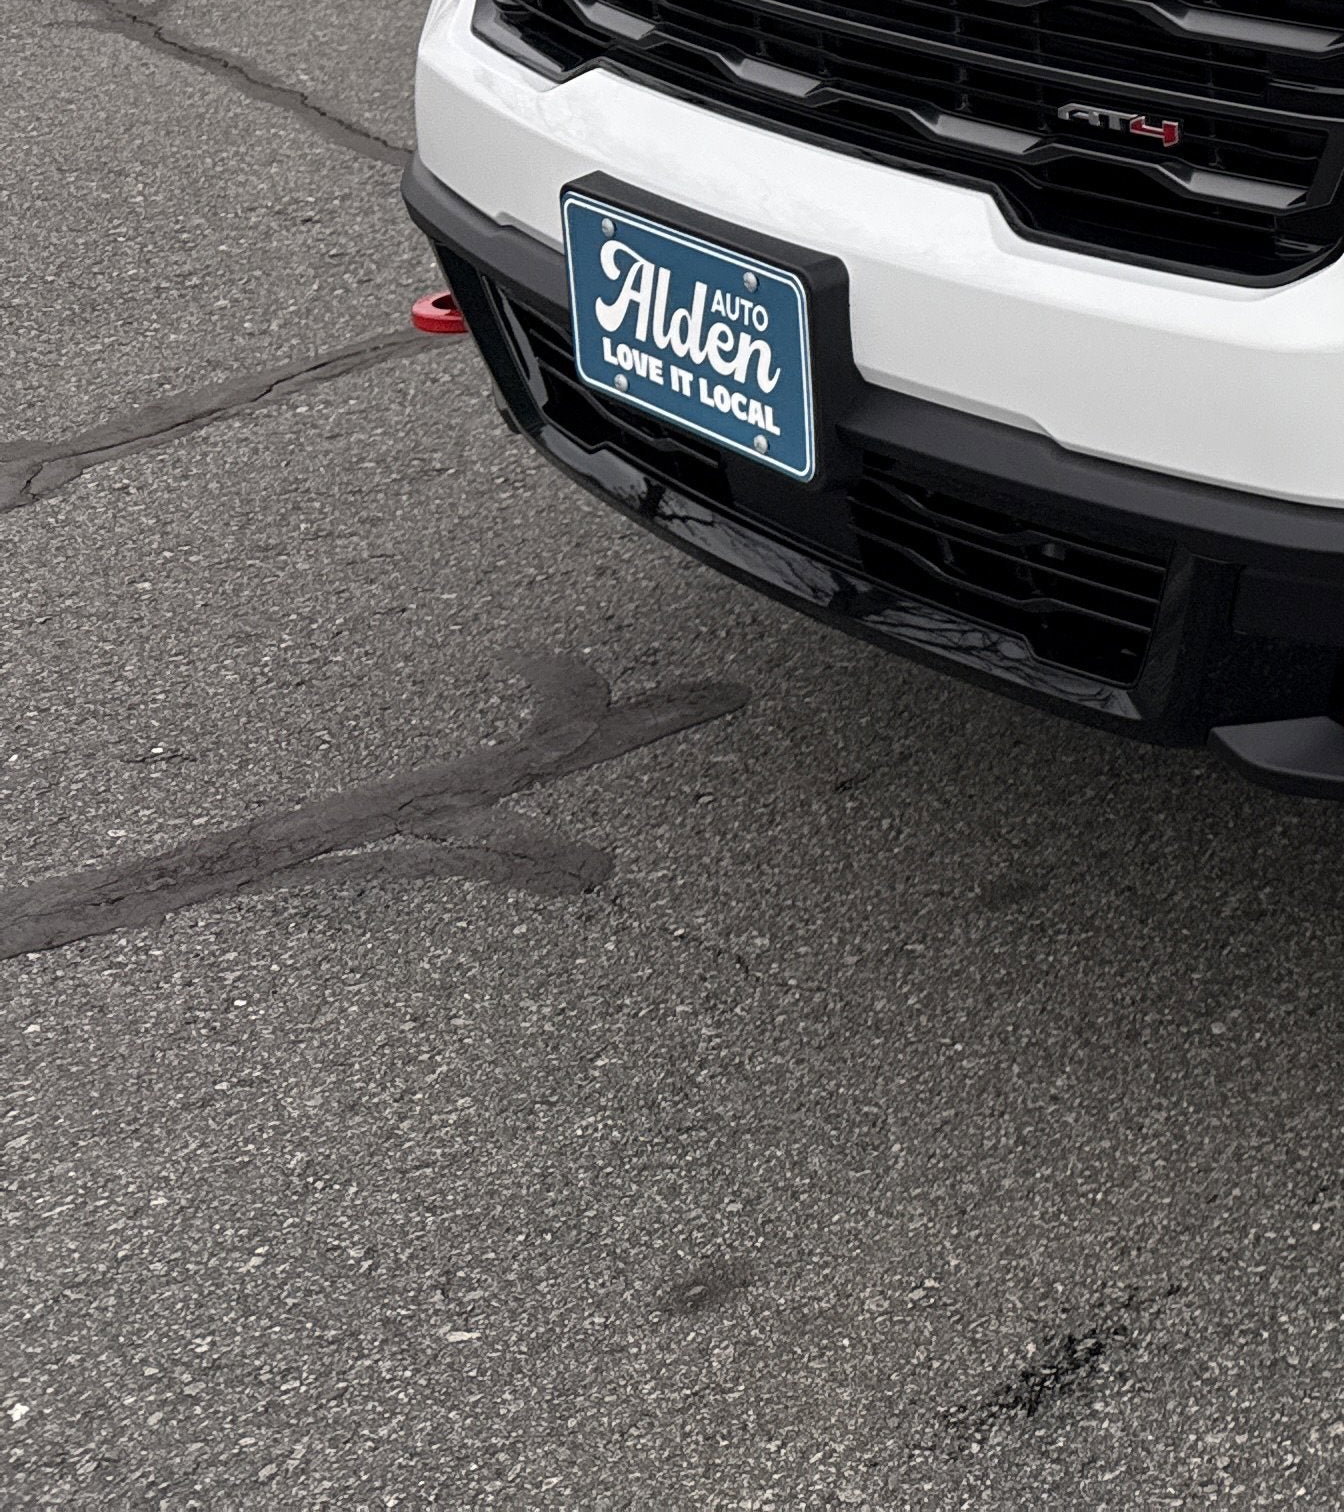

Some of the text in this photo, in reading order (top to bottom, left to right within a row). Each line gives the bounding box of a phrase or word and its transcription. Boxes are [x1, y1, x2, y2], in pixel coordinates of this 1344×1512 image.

[1058, 102, 1179, 148] AT4
[595, 240, 781, 393] Alden
[711, 290, 769, 332] AUTO
[602, 337, 781, 436] LOVE IT LOCAL
